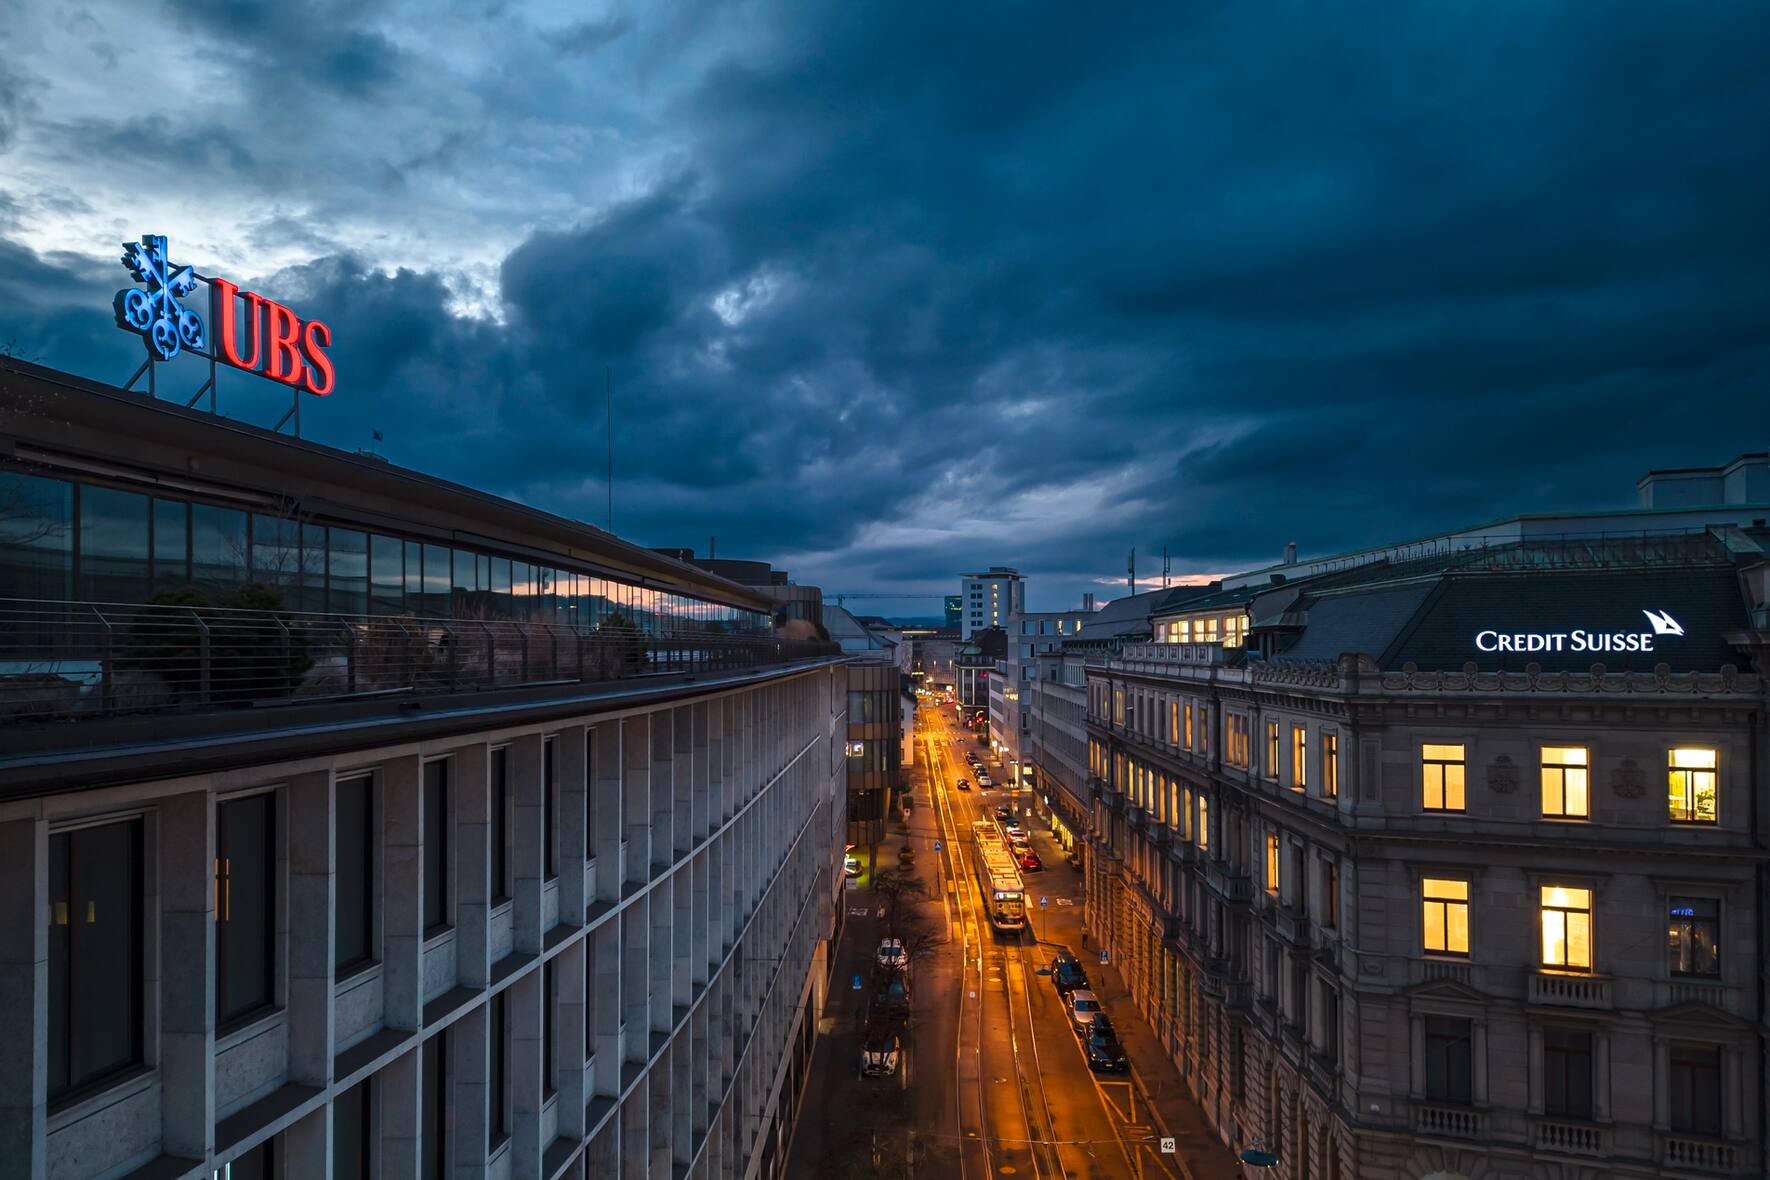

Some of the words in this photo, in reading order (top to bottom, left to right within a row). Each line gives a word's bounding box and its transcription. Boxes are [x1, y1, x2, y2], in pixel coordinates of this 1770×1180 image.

[216, 278, 335, 396] UBS
[1475, 631, 1567, 652] CREDIT
[1571, 630, 1654, 652] SUISSE
[1162, 1141, 1174, 1150] 42
